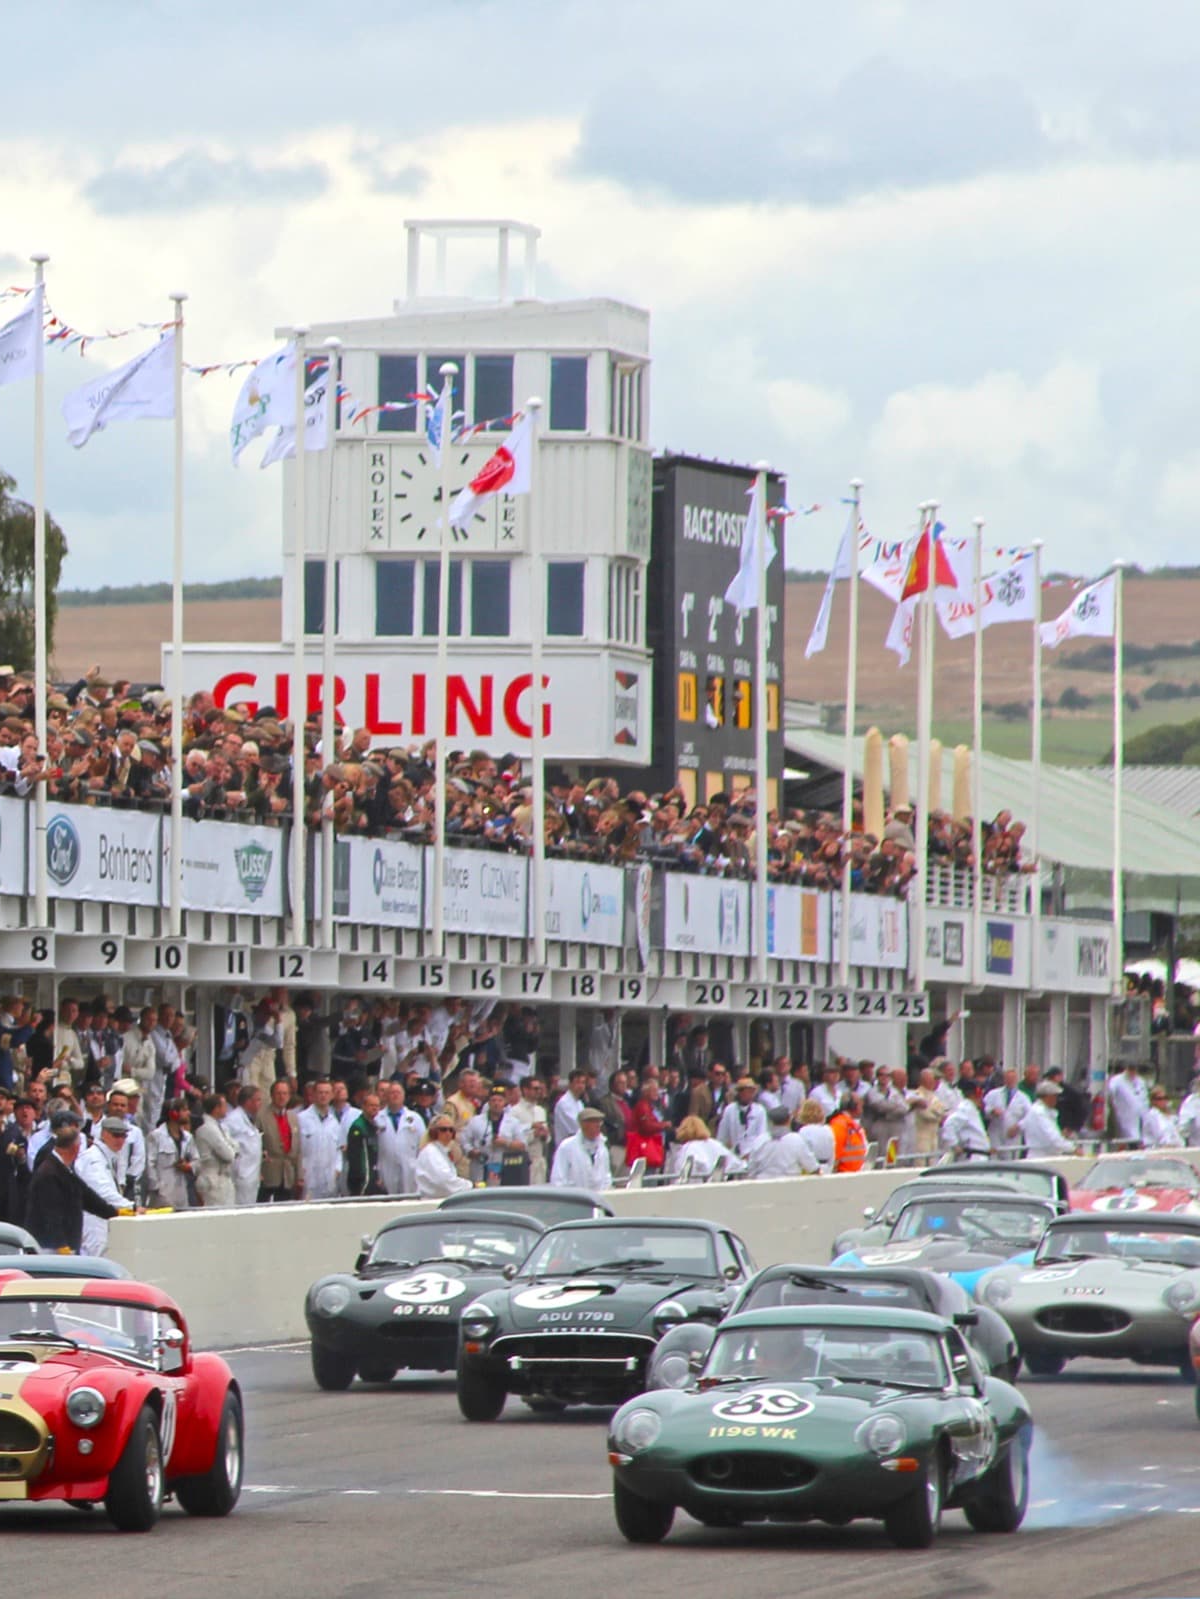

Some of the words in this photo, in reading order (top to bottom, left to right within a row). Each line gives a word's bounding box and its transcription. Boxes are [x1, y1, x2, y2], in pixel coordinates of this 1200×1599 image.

[371, 453, 386, 540] ROLEX
[683, 505, 714, 543] RACE
[212, 671, 552, 738] GIRLING
[99, 832, 152, 884] Bonhams
[31, 936, 48, 961] 8
[100, 940, 118, 964] 9
[154, 946, 181, 969] 10
[228, 951, 244, 974] 11
[279, 955, 304, 978] 12
[362, 960, 388, 982] 14
[420, 965, 443, 986] 15
[471, 968, 495, 989] 16
[522, 972, 544, 992] 17
[571, 975, 595, 996] 18
[619, 979, 641, 999] 19
[695, 984, 724, 1004] 20
[746, 988, 768, 1007] 21
[779, 990, 808, 1010] 22
[821, 993, 848, 1013] 23
[858, 995, 886, 1015] 24
[896, 998, 925, 1018] 25
[401, 1279, 449, 1295] 31
[417, 1305, 450, 1315] FXN
[538, 1312, 573, 1322] ADU
[577, 1312, 615, 1322] 179B
[708, 1426, 758, 1438] 1196
[761, 1426, 798, 1440] WK
